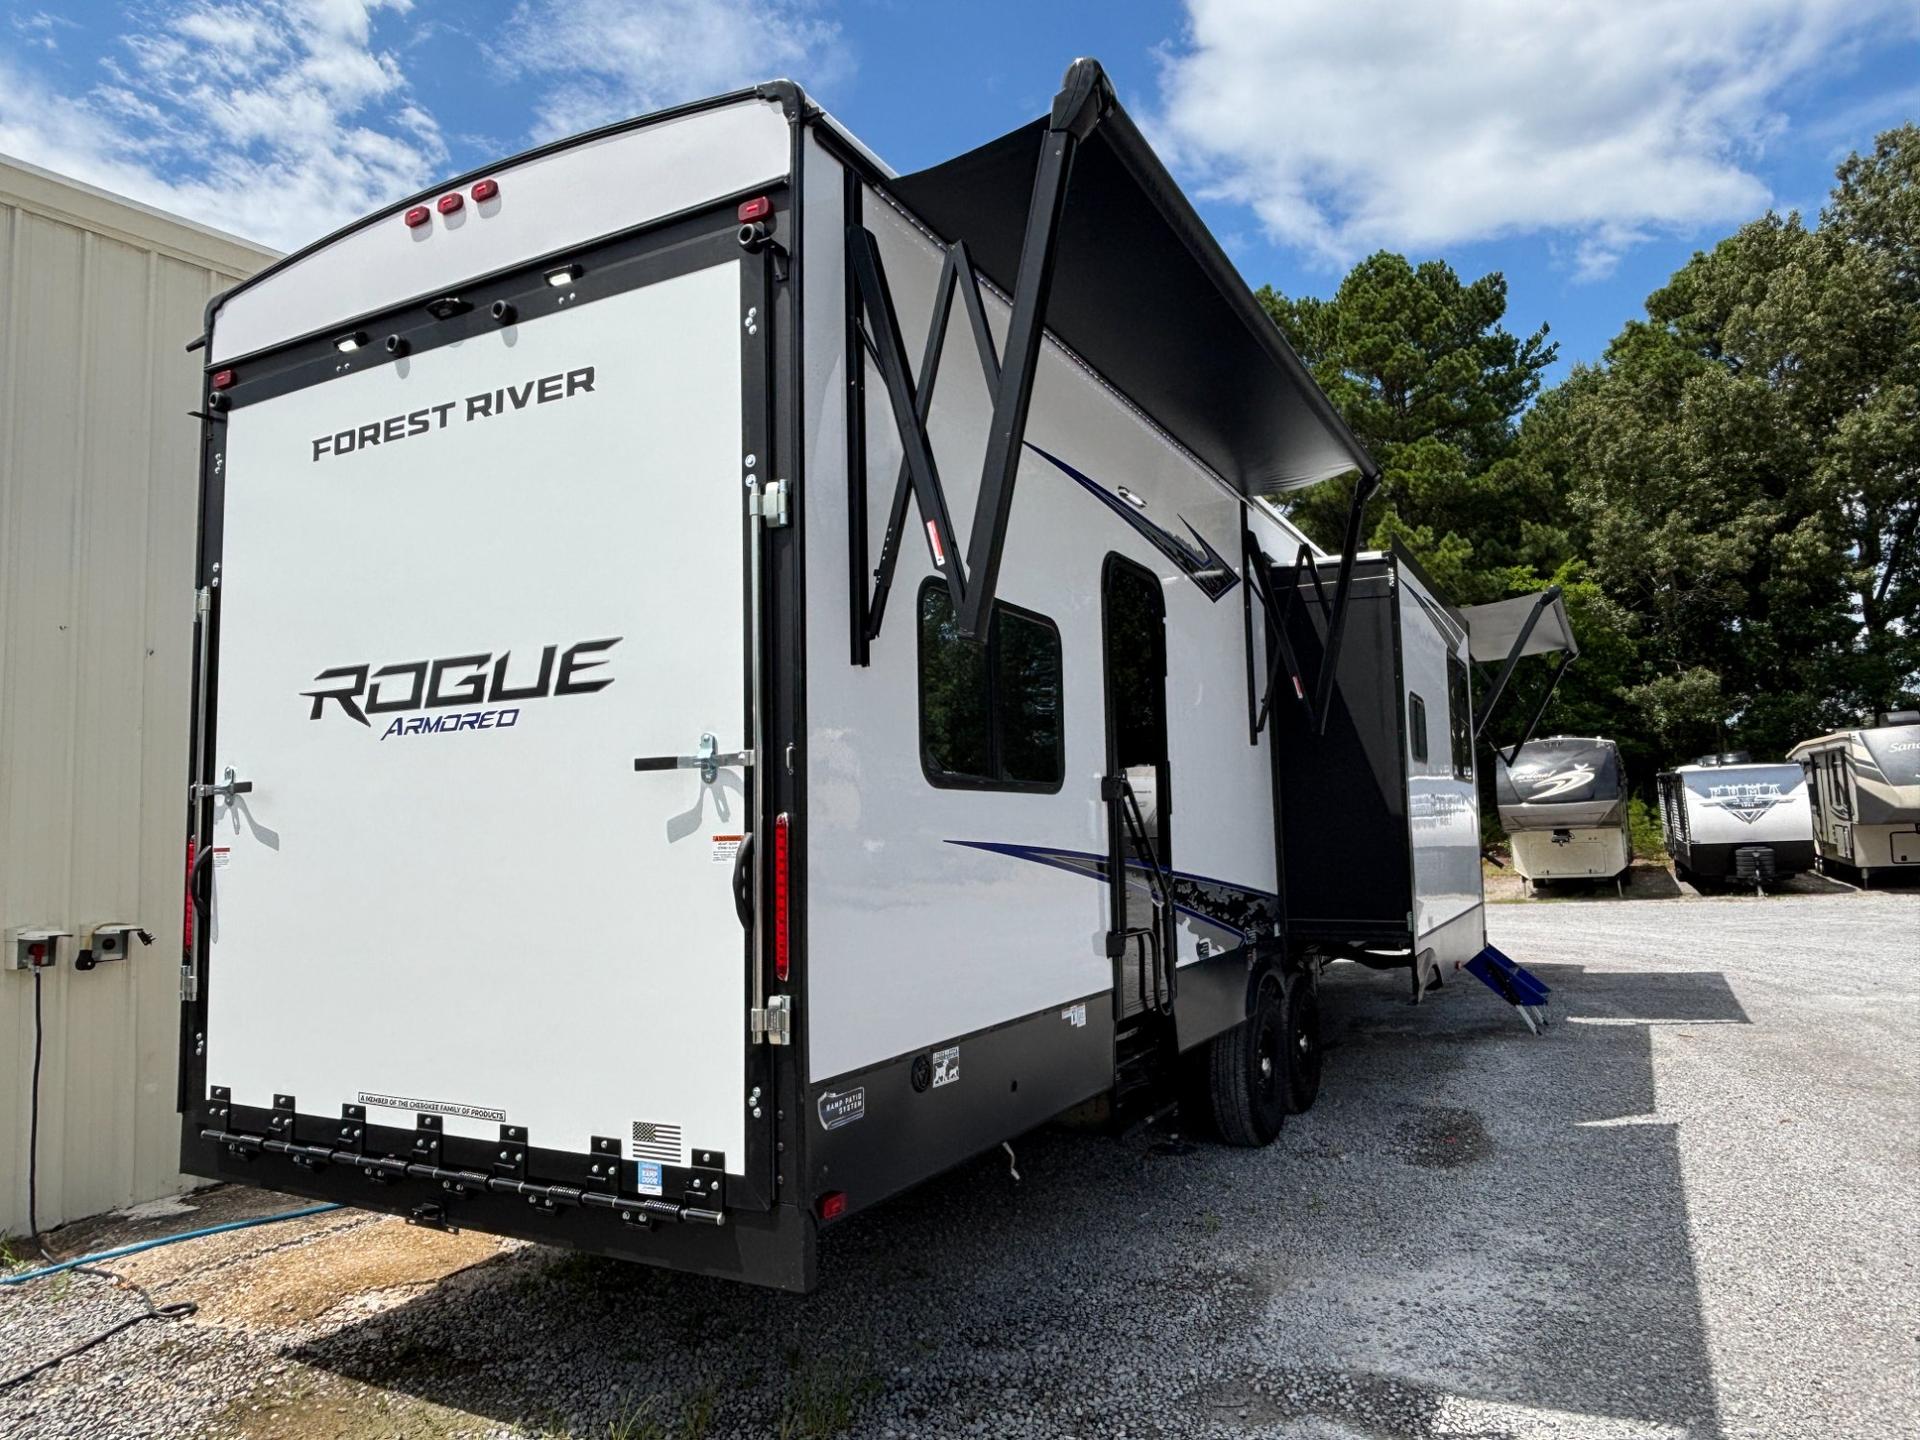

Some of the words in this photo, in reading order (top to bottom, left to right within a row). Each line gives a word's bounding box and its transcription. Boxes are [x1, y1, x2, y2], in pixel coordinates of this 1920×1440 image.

[312, 401, 456, 462] FOREST
[465, 366, 596, 422] RIVER
[298, 636, 624, 728] ROGUE
[381, 709, 520, 741] ARMORED
[1708, 783, 1781, 799] PUMA
[366, 1096, 389, 1106] MEMBER
[398, 1100, 408, 1108] THE
[409, 1101, 439, 1112] CHEROKEE
[440, 1103, 461, 1114] FAMILY
[461, 1107, 470, 1115] OF
[471, 1109, 504, 1120] PRODUCTS
